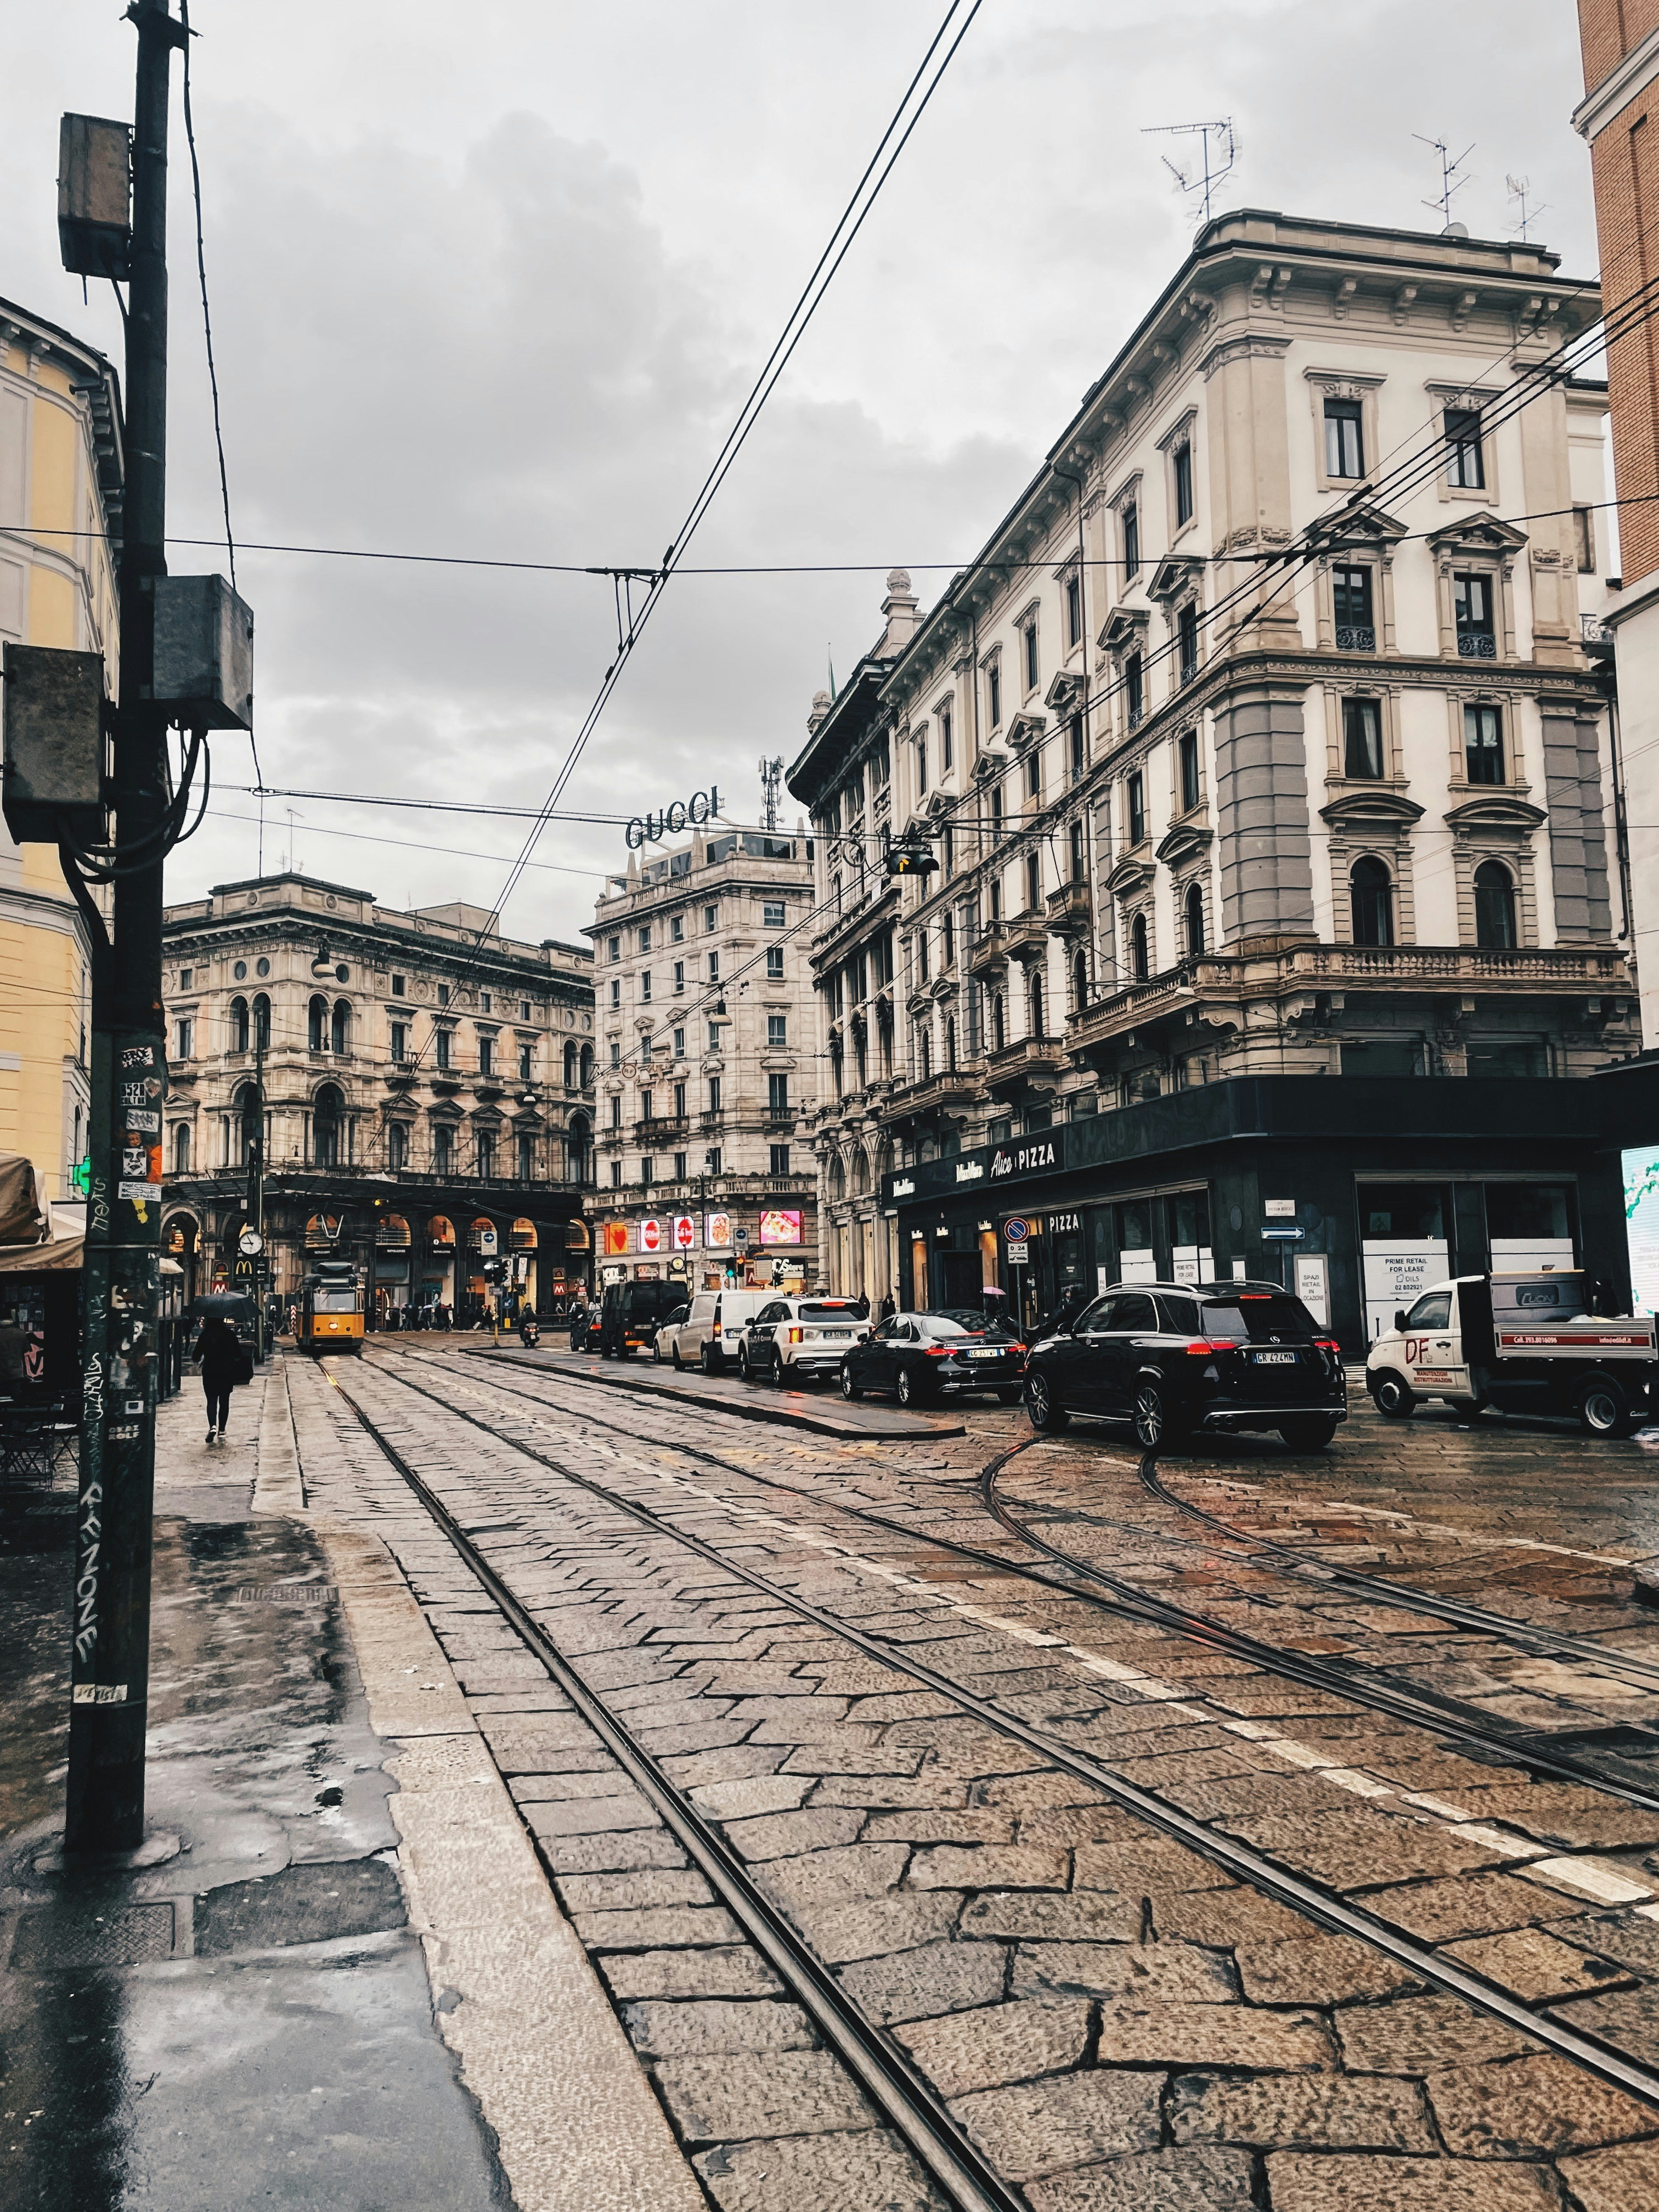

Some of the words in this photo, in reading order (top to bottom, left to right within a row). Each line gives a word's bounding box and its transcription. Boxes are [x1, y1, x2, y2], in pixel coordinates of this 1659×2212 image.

[626, 786, 718, 849] GUCCI
[991, 1150, 1013, 1178] Alice
[1018, 1143, 1055, 1170] PIZZA
[1049, 1214, 1079, 1231] PIZZA
[554, 1285, 565, 1294] M
[1257, 1353, 1267, 1362] GR
[1269, 1353, 1294, 1362] 424MN
[1406, 1338, 1430, 1364] DF
